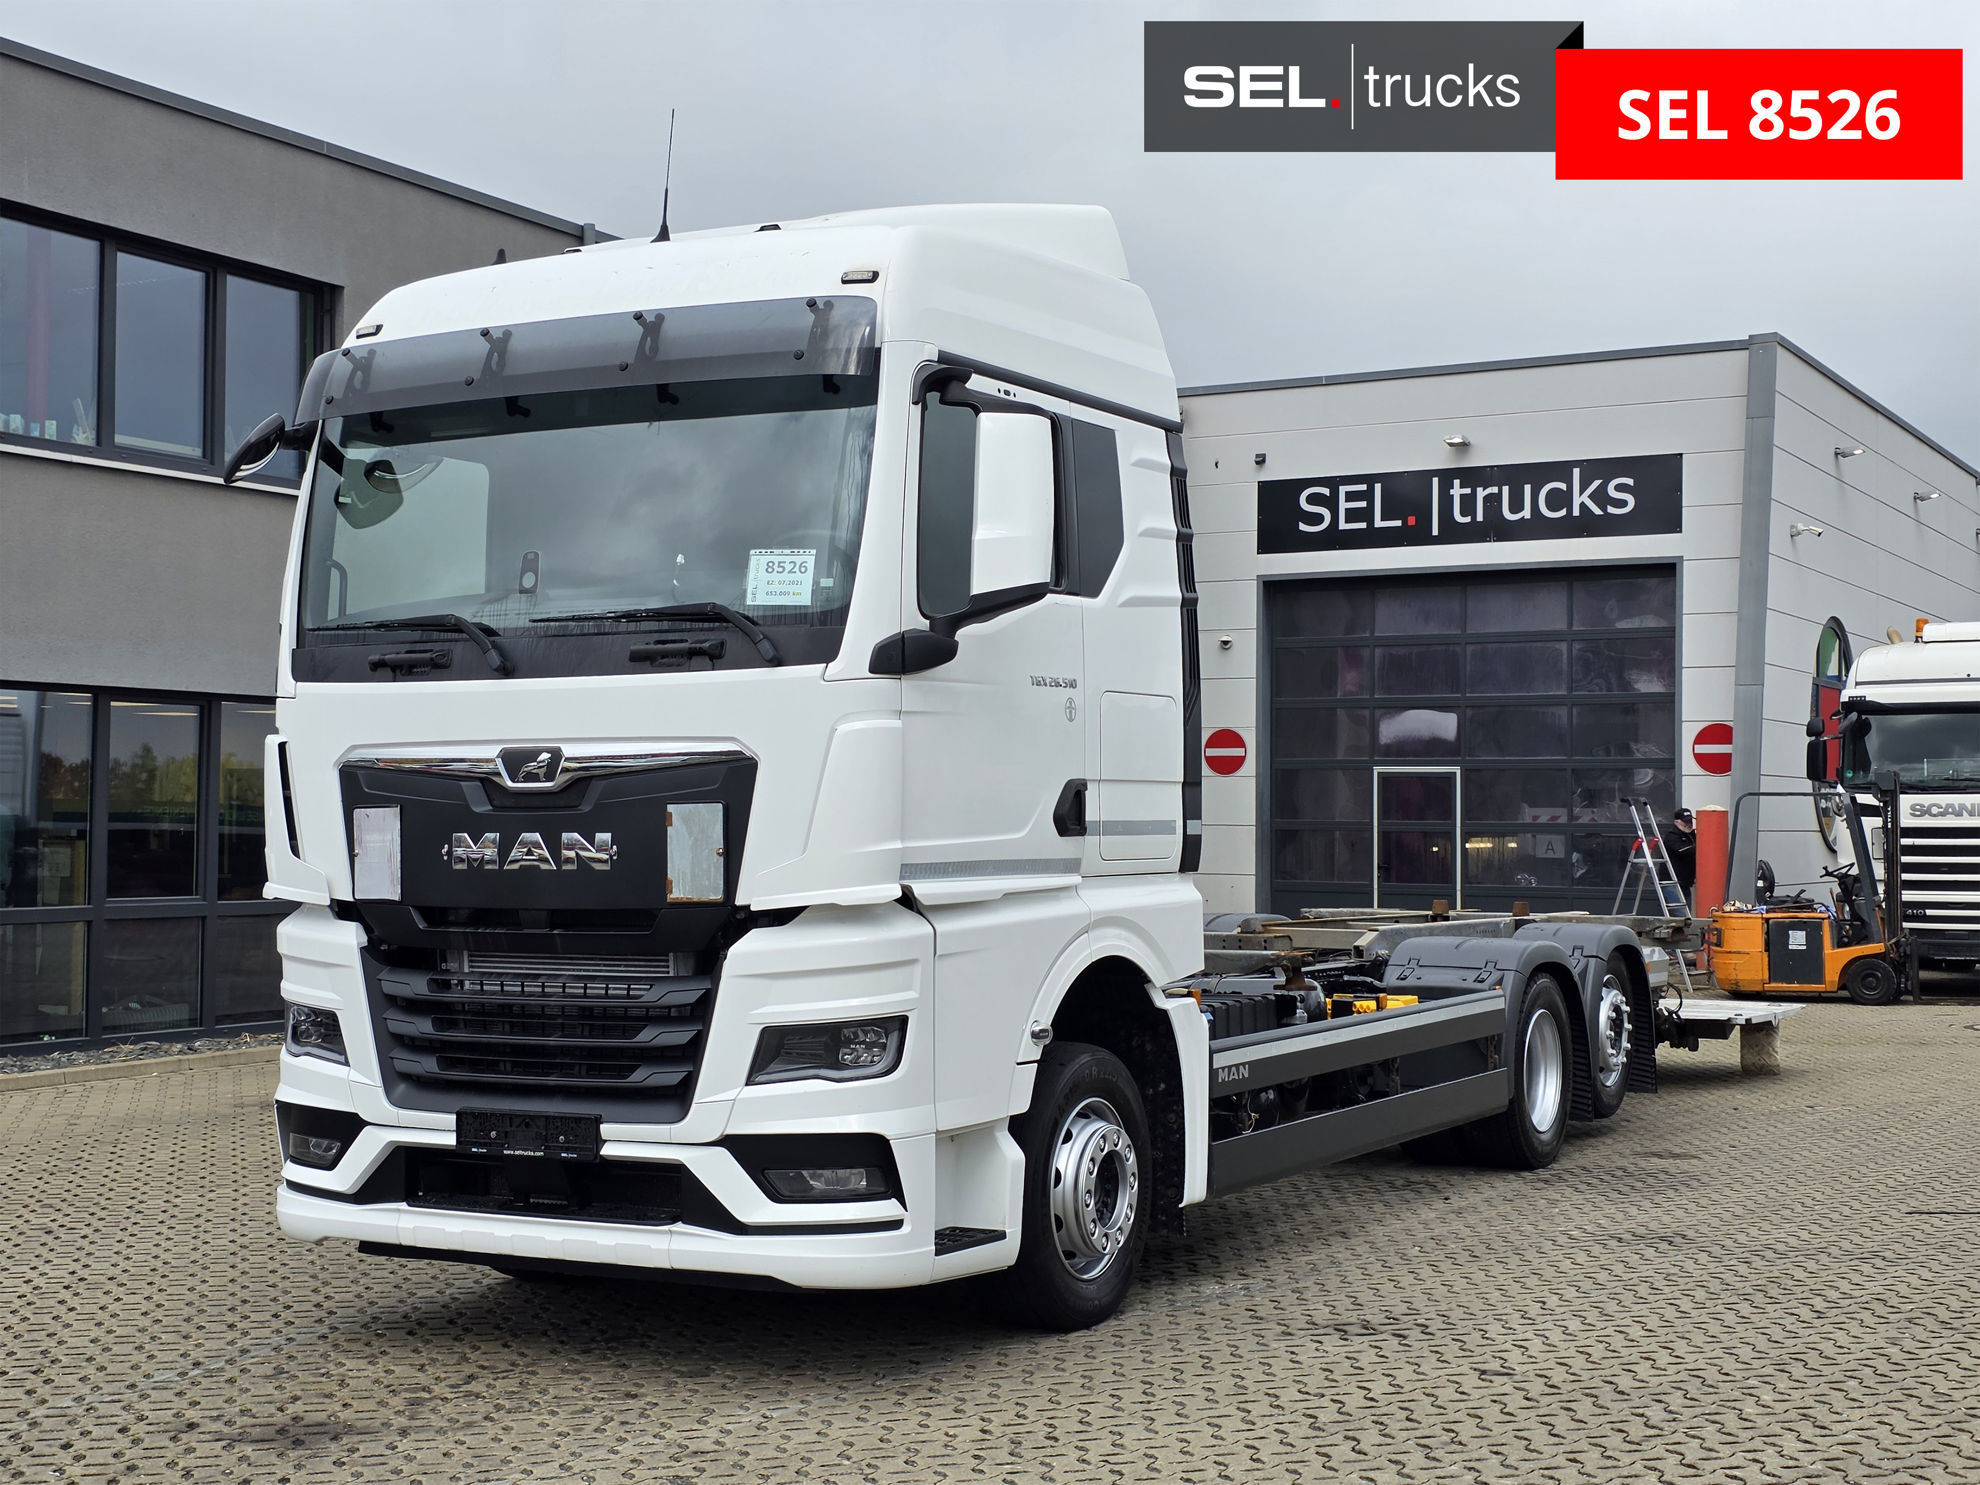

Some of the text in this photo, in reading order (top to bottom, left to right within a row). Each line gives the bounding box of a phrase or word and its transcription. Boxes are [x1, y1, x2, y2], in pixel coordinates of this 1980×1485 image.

[1450, 467, 1636, 524] trucks
[765, 560, 808, 575] 8526
[452, 832, 613, 870] MAN
[1544, 840, 1556, 855] A
[1217, 1063, 1250, 1083] MAN
